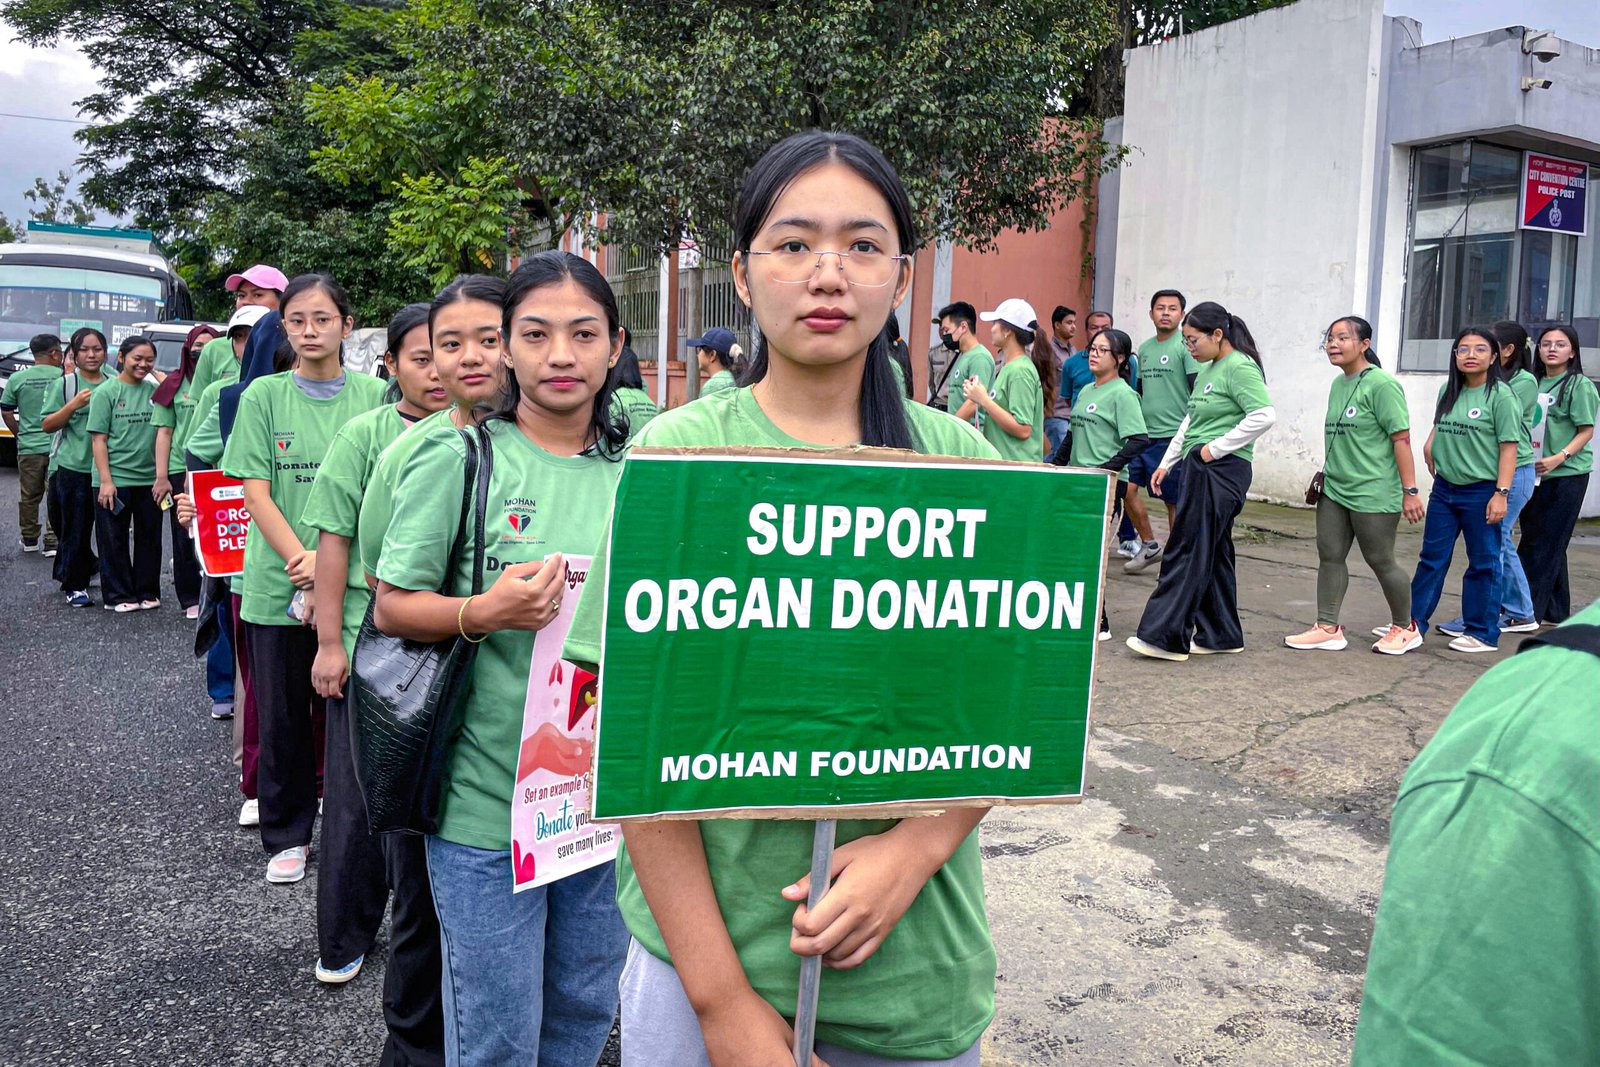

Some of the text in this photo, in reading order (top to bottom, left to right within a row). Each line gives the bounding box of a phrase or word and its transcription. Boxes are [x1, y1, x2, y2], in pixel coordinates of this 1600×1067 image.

[1529, 169, 1586, 188] CITY CONVENTION CENTRE
[1537, 185, 1576, 199] POLICE POST
[504, 497, 536, 507] MOHAN
[746, 502, 987, 559] SUPPORT
[624, 577, 1085, 633] ORGAN DONATION
[660, 744, 1033, 783] MOHAN FOUNDATION
[524, 788, 537, 804] Set
[538, 788, 549, 800] an
[549, 776, 582, 798] example
[535, 799, 573, 841] Donate
[557, 830, 614, 859] save many lives.
